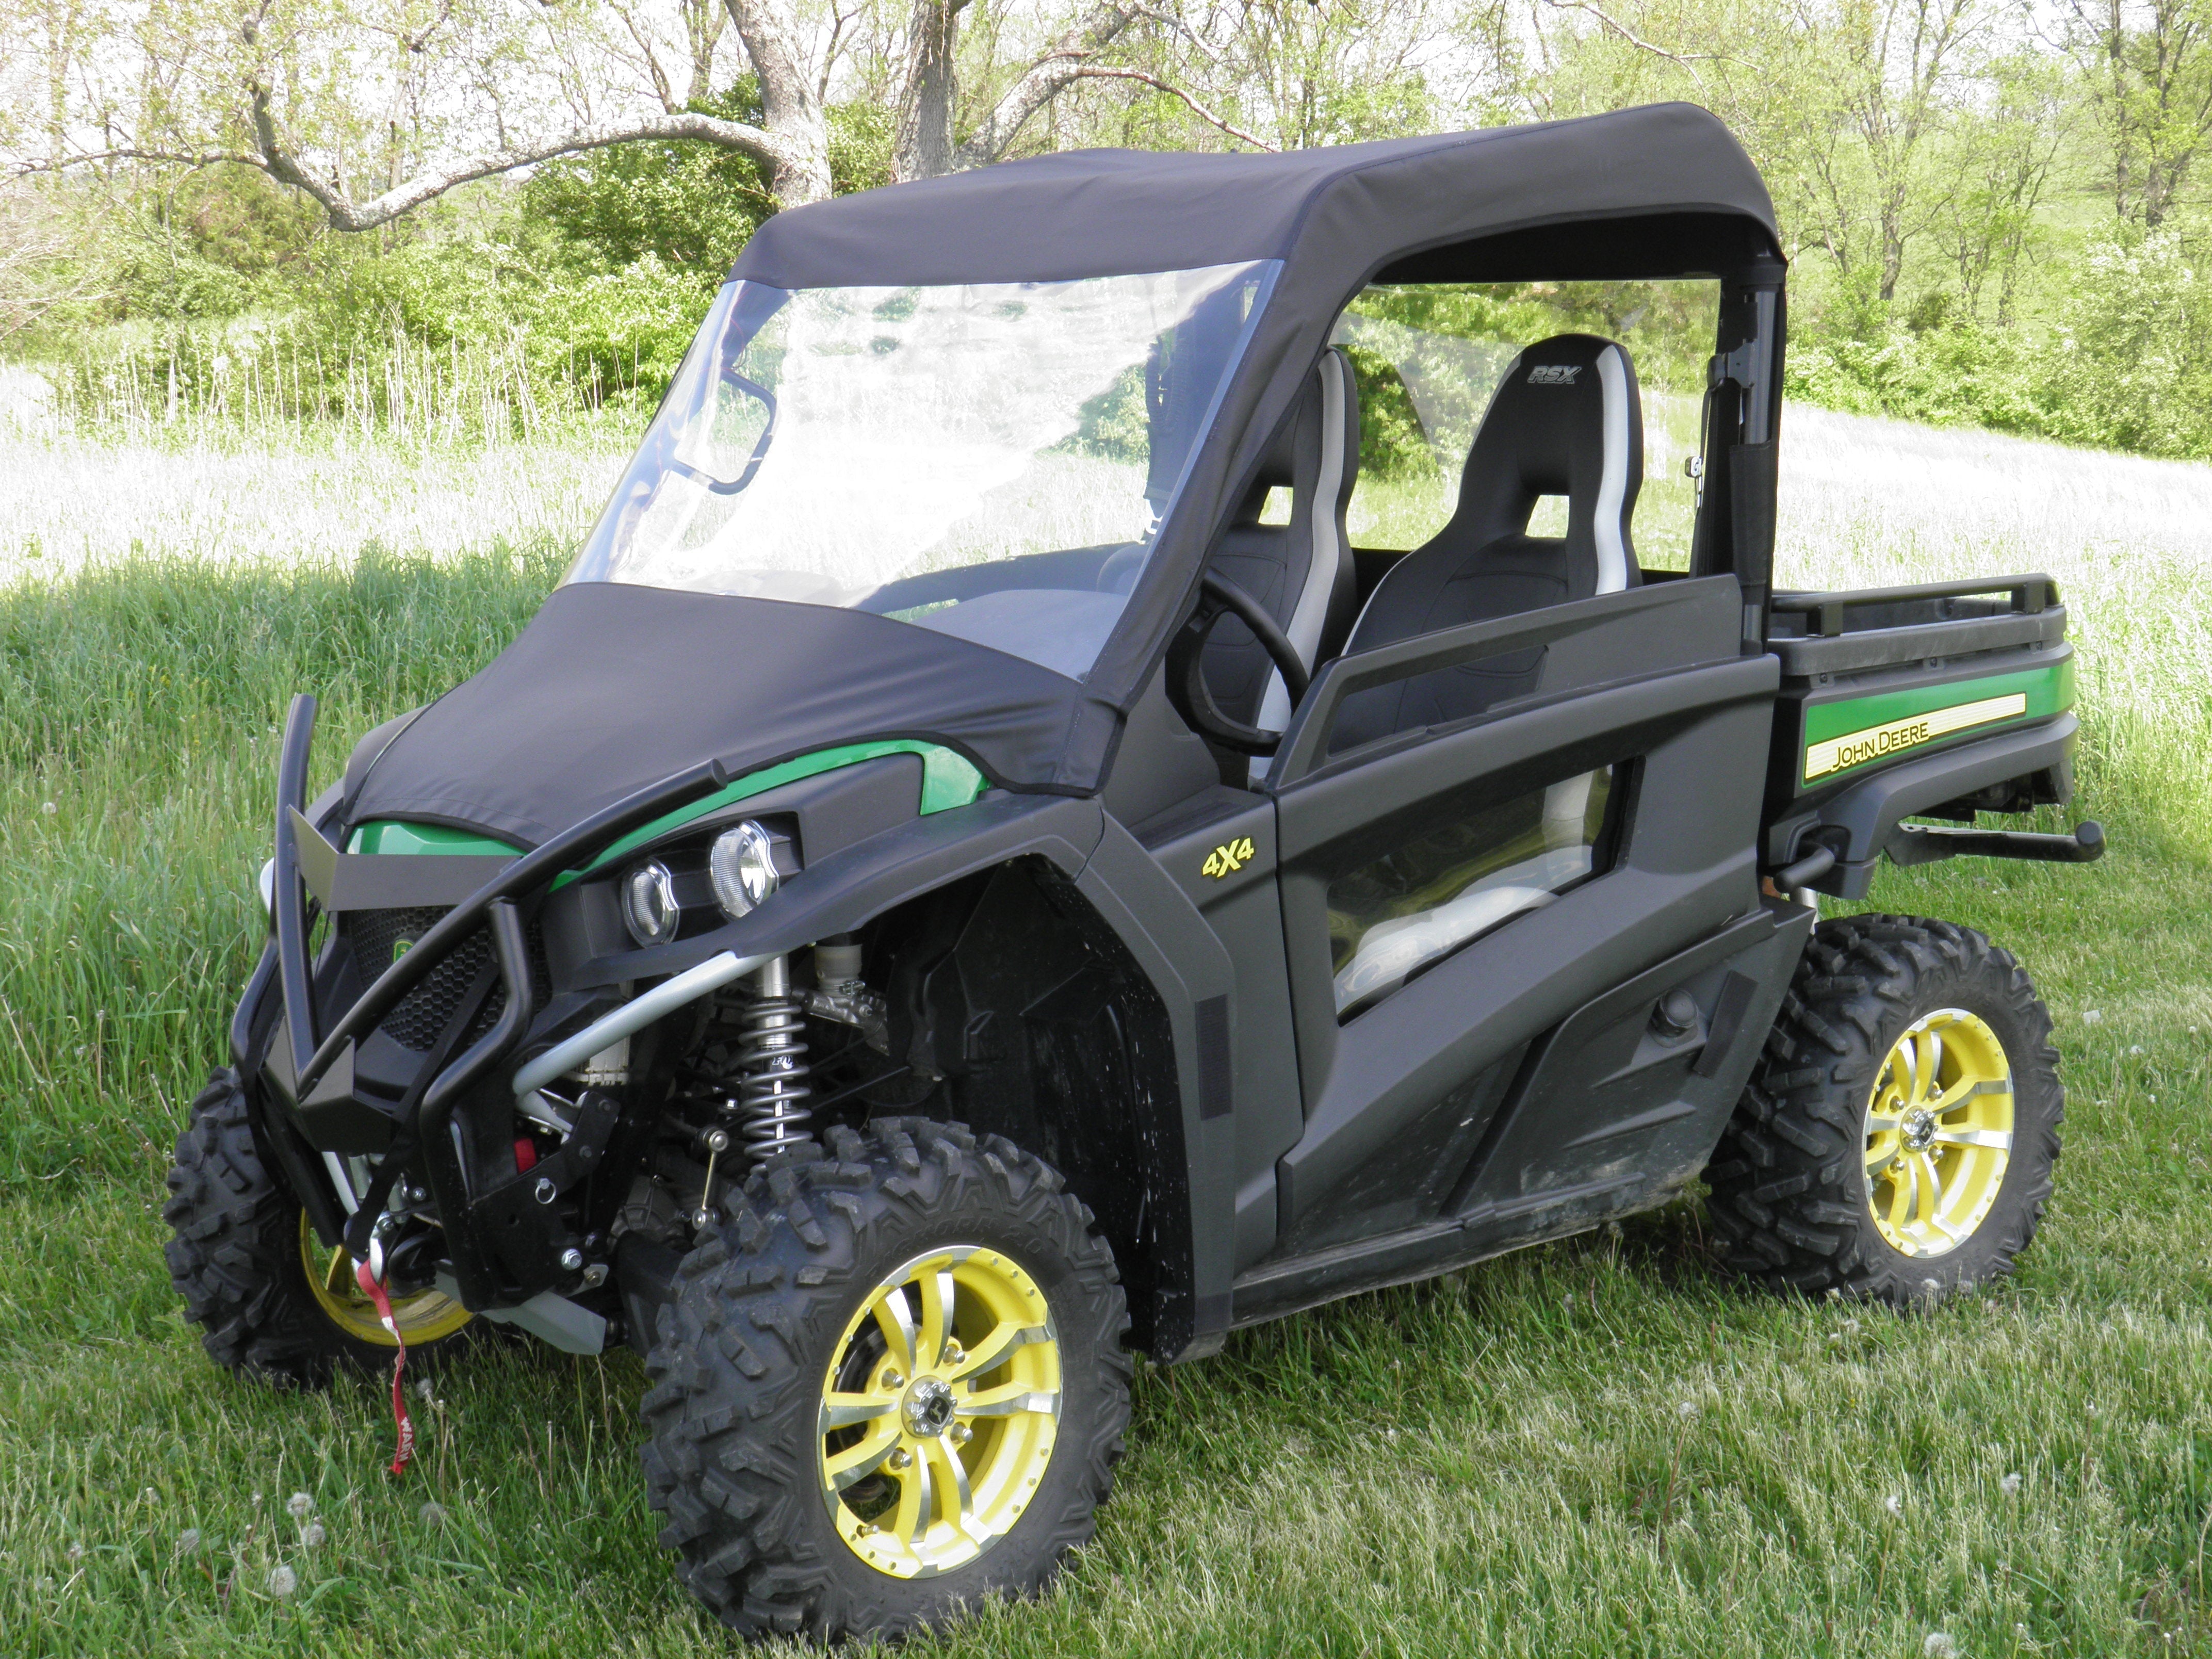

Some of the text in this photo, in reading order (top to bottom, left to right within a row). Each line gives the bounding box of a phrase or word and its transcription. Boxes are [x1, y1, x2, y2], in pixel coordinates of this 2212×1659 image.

[1527, 365, 1582, 384] RSX
[1832, 722, 1929, 769] JOHN DEERE
[1202, 837, 1255, 878] 4X4
[398, 1416, 413, 1462] WARN
